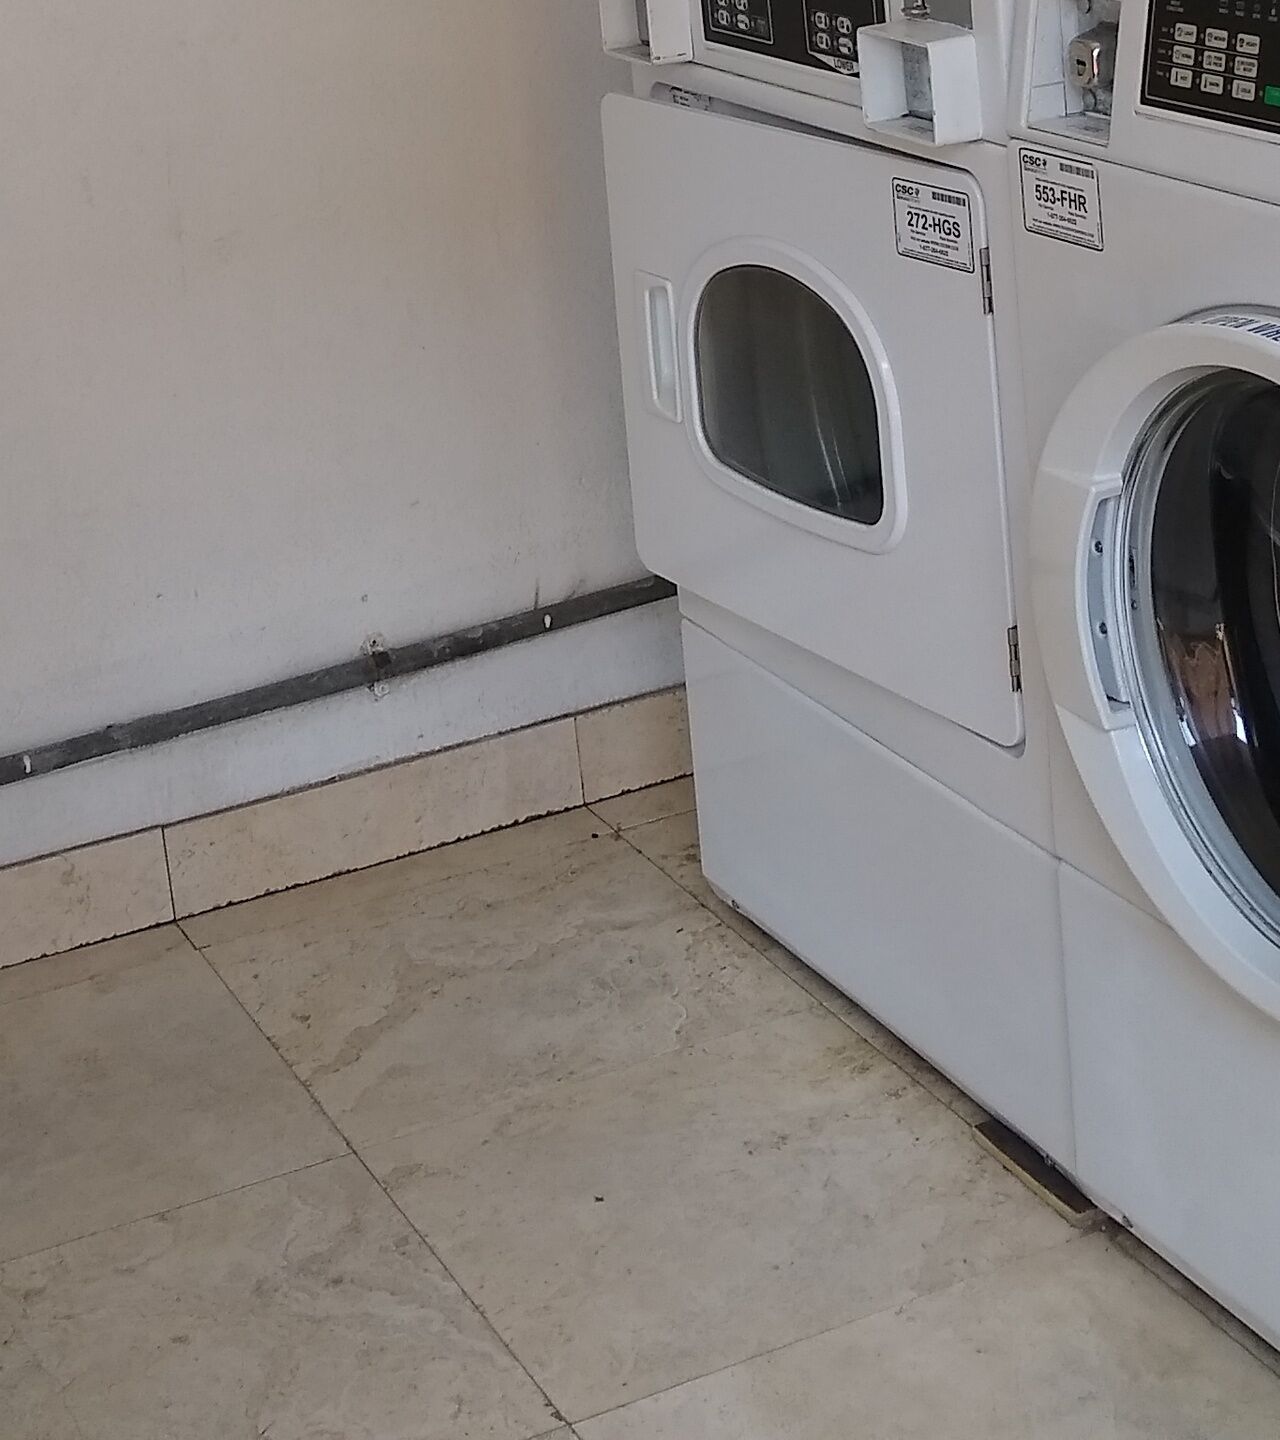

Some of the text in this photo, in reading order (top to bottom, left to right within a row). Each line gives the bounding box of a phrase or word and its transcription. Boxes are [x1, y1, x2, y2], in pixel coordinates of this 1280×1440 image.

[833, 59, 855, 73] LOWER
[1022, 153, 1041, 168] CSC
[895, 183, 914, 197] CSC
[1034, 184, 1088, 214] 553-FHR
[906, 210, 961, 239] 272-HGS
